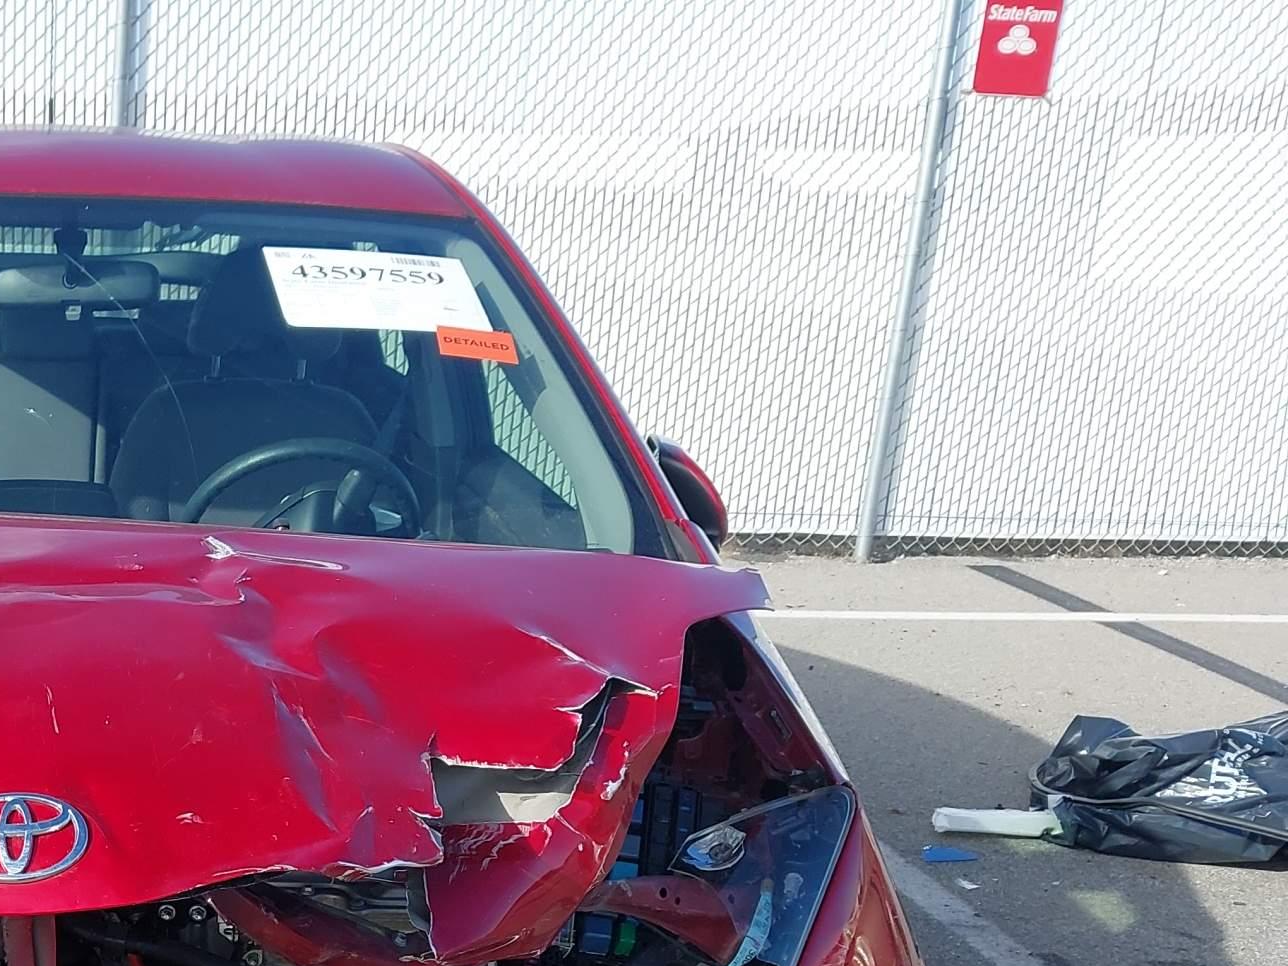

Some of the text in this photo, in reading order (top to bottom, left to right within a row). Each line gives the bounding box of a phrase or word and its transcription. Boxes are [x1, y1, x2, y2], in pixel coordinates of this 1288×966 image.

[988, 3, 1058, 23] StateFarm
[291, 264, 445, 286] 43597559
[443, 336, 510, 352] DETAILED
